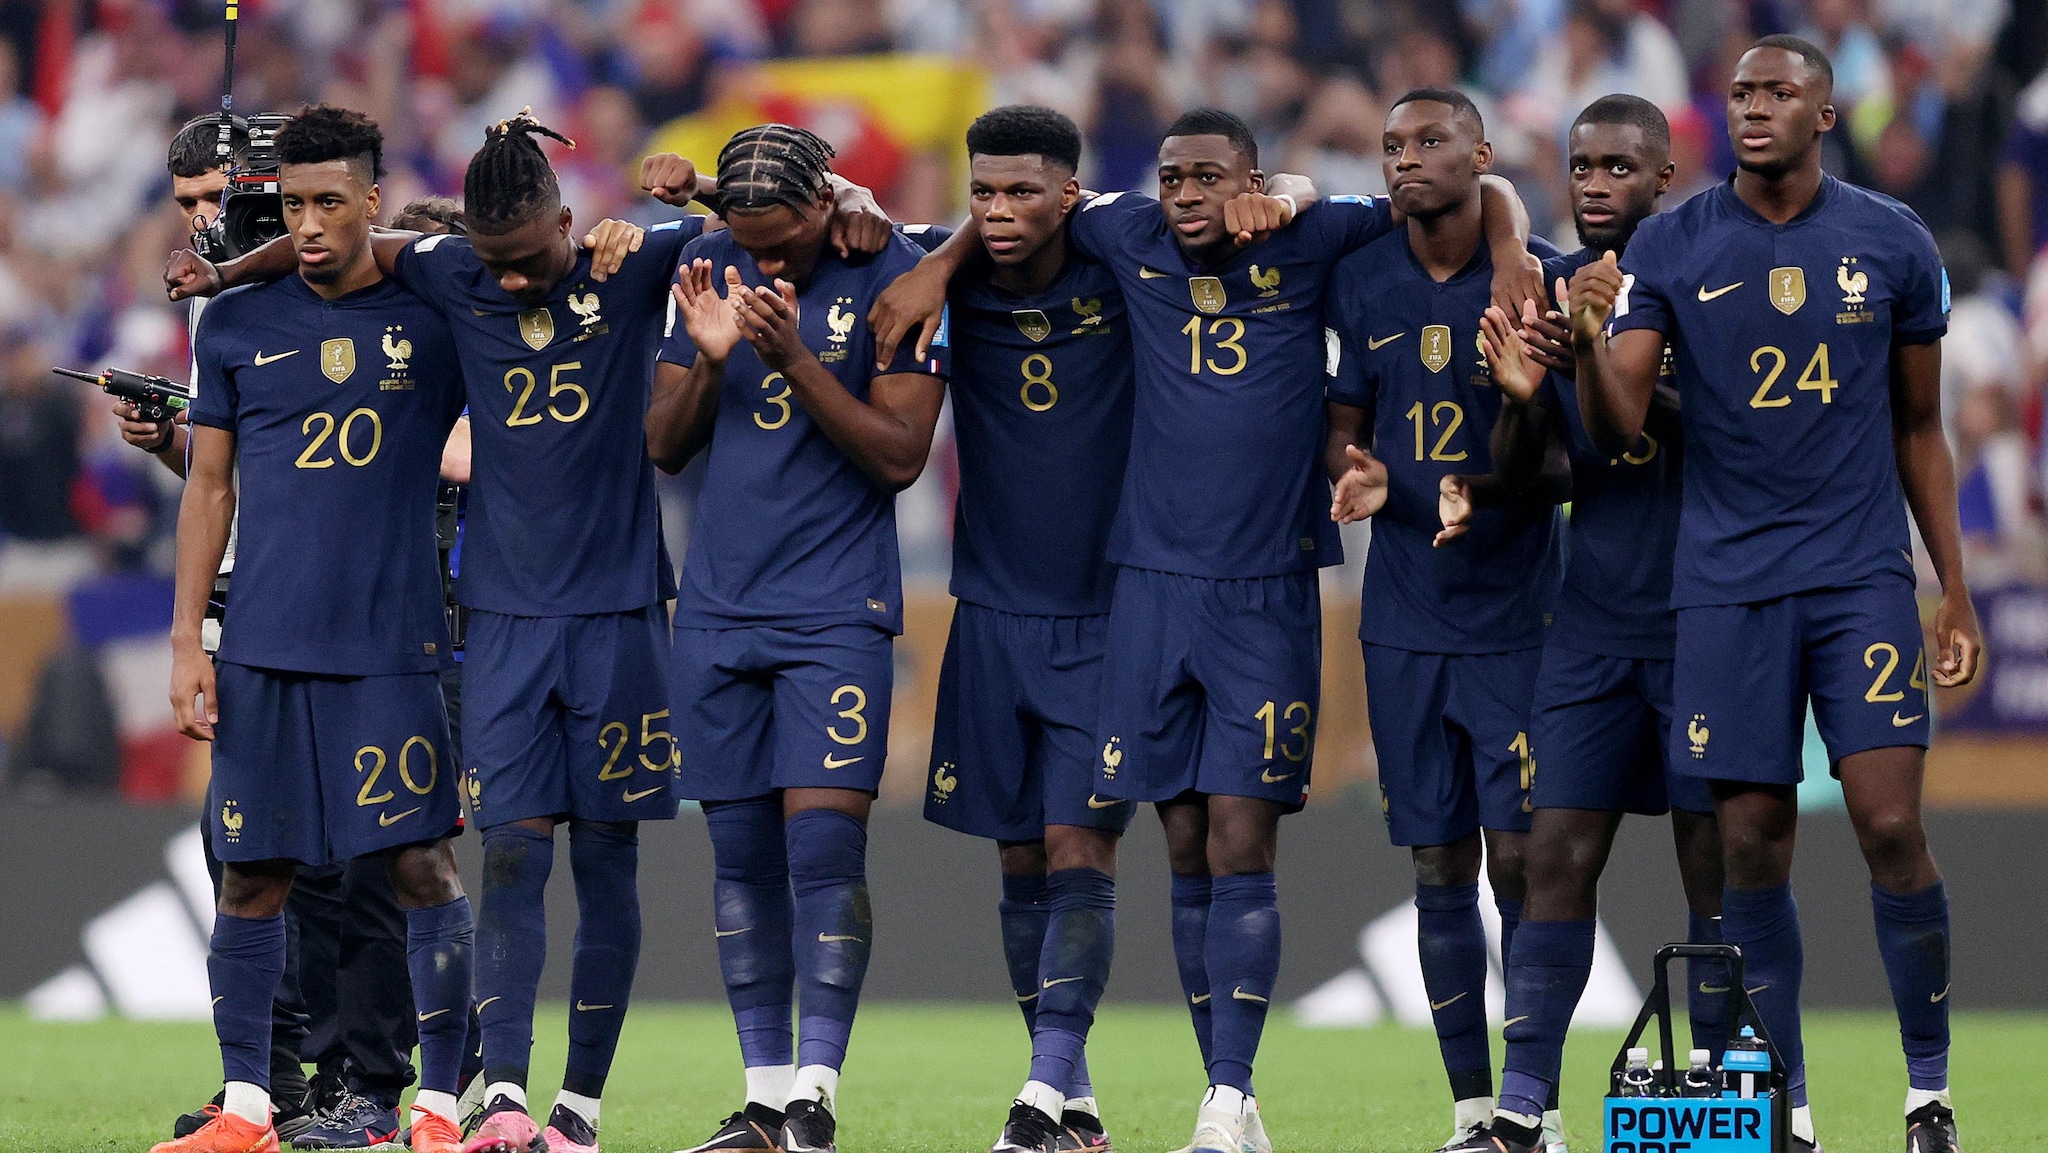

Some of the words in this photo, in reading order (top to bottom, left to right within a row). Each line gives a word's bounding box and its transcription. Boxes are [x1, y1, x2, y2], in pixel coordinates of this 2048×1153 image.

[1181, 315, 1248, 376] 13
[1749, 342, 1839, 409] 24
[503, 361, 590, 428] 25
[753, 372, 793, 431] 3
[1020, 353, 1059, 412] 8
[294, 407, 384, 469] 20
[1405, 400, 1469, 462] 12
[1863, 642, 1928, 704] 24
[597, 708, 673, 782] 25
[826, 684, 868, 746] 3
[1254, 700, 1312, 762] 13
[354, 735, 438, 807] 20
[1507, 731, 1530, 790] 1
[1610, 1107, 1761, 1139] POWER
